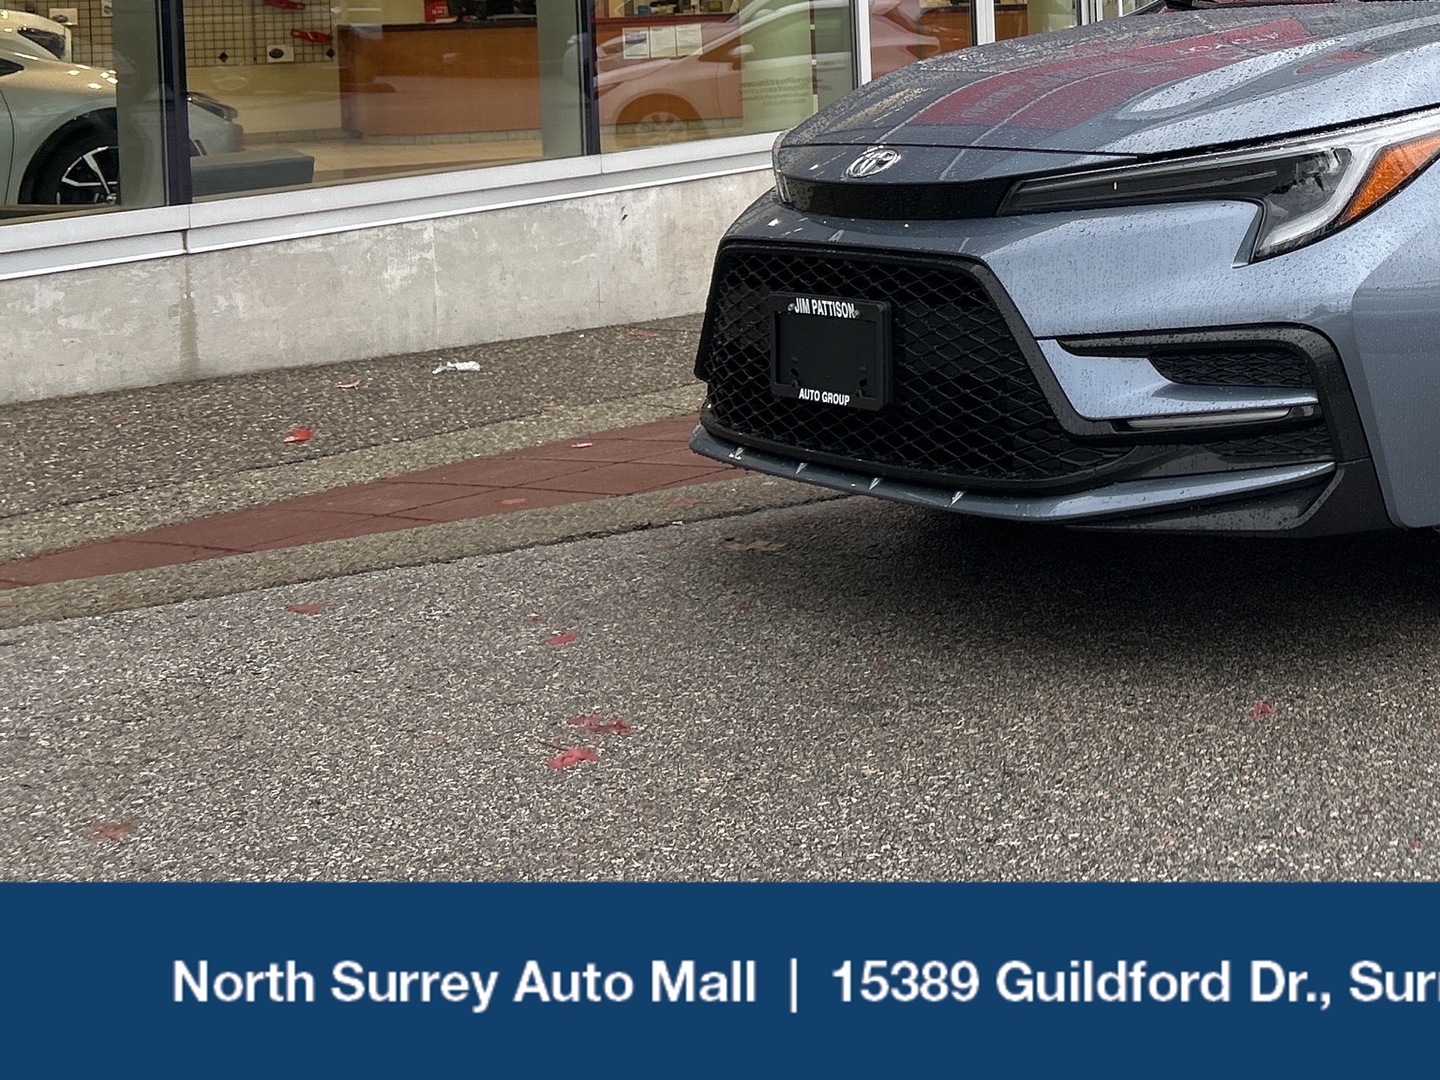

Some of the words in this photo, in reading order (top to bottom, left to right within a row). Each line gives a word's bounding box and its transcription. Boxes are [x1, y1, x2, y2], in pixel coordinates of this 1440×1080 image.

[794, 297, 811, 314] JIM
[811, 299, 856, 319] PATTISON
[799, 388, 820, 401] AUTO
[821, 391, 850, 406] GROUP
